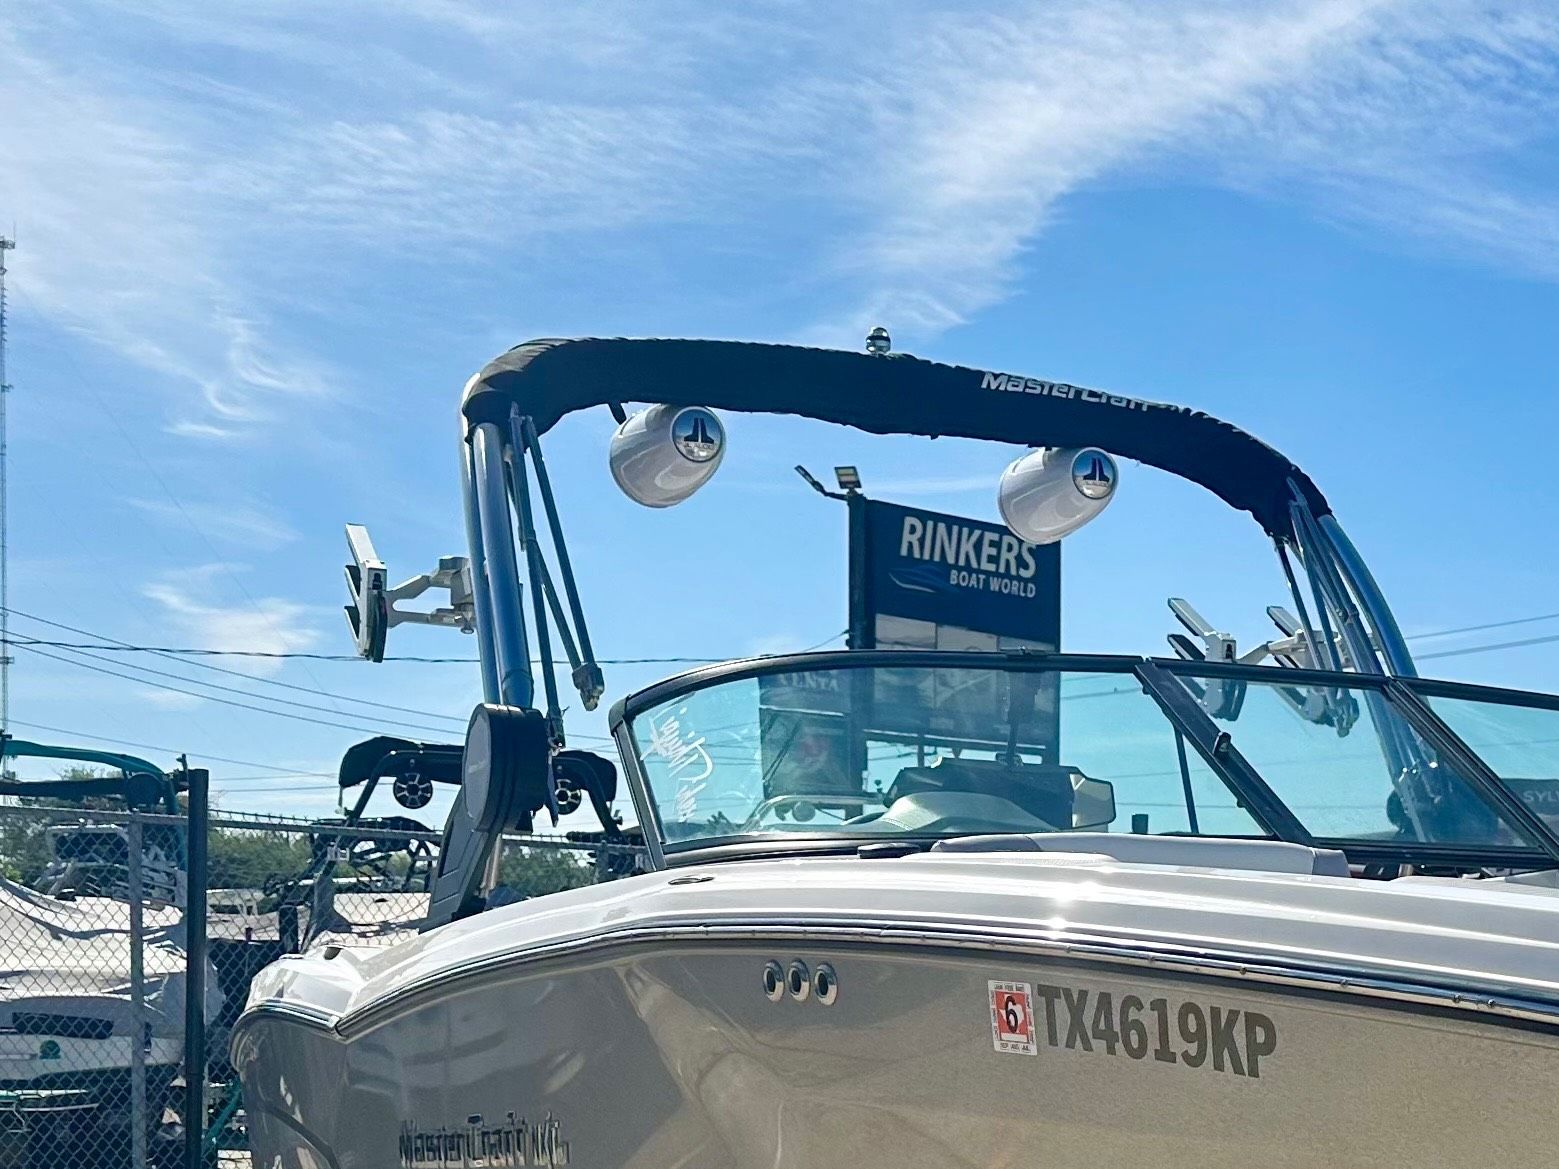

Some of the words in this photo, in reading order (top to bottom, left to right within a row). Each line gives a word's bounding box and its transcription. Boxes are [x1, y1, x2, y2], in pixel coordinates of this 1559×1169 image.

[900, 516, 1036, 578] RINKERS
[949, 569, 985, 590] BOAT
[989, 576, 1036, 598] WORLD
[1005, 995, 1018, 1034] 6
[1037, 983, 1277, 1079] TX4619KP
